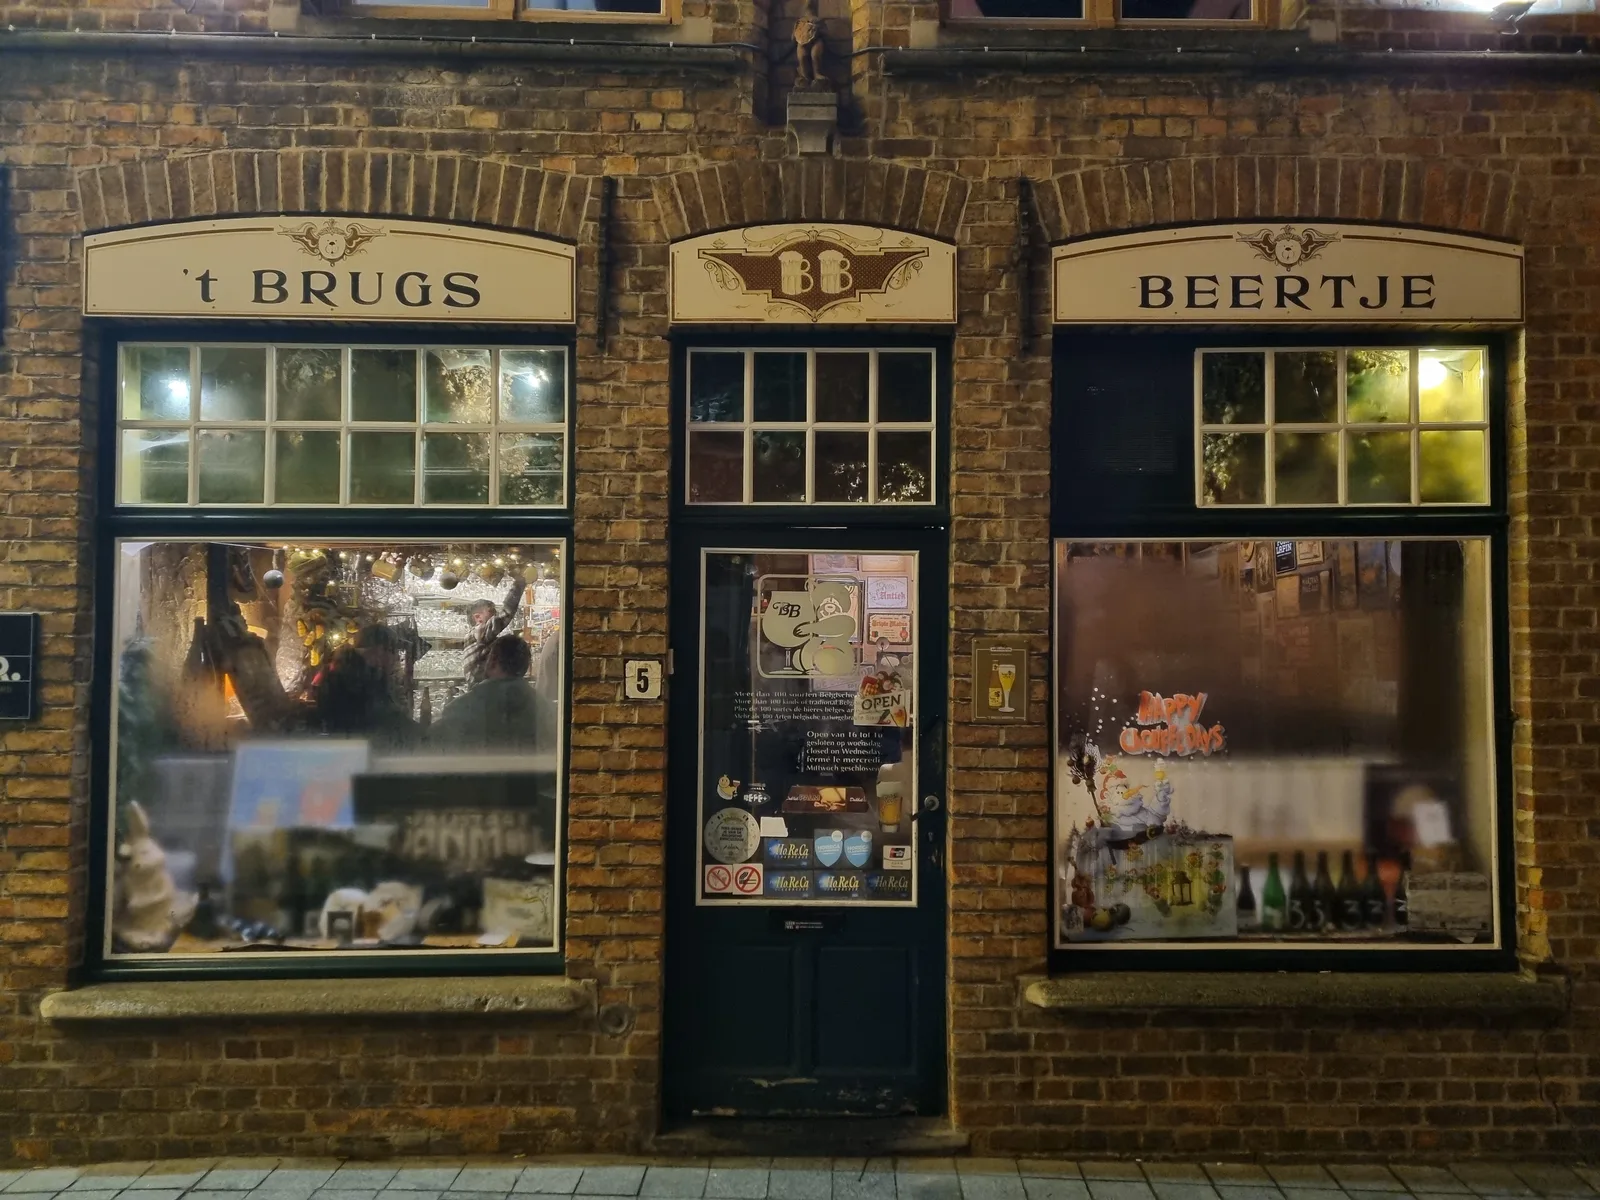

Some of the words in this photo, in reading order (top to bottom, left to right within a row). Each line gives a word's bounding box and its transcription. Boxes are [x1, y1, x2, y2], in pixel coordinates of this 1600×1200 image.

[182, 268, 218, 303] 't
[251, 268, 482, 309] BRUGS
[1137, 273, 1437, 310] BEERTJE
[636, 667, 649, 693] 5
[862, 694, 901, 710] OPEN
[1138, 690, 1207, 726] HAPPY
[806, 730, 829, 739] Open
[806, 739, 835, 747] gesloten
